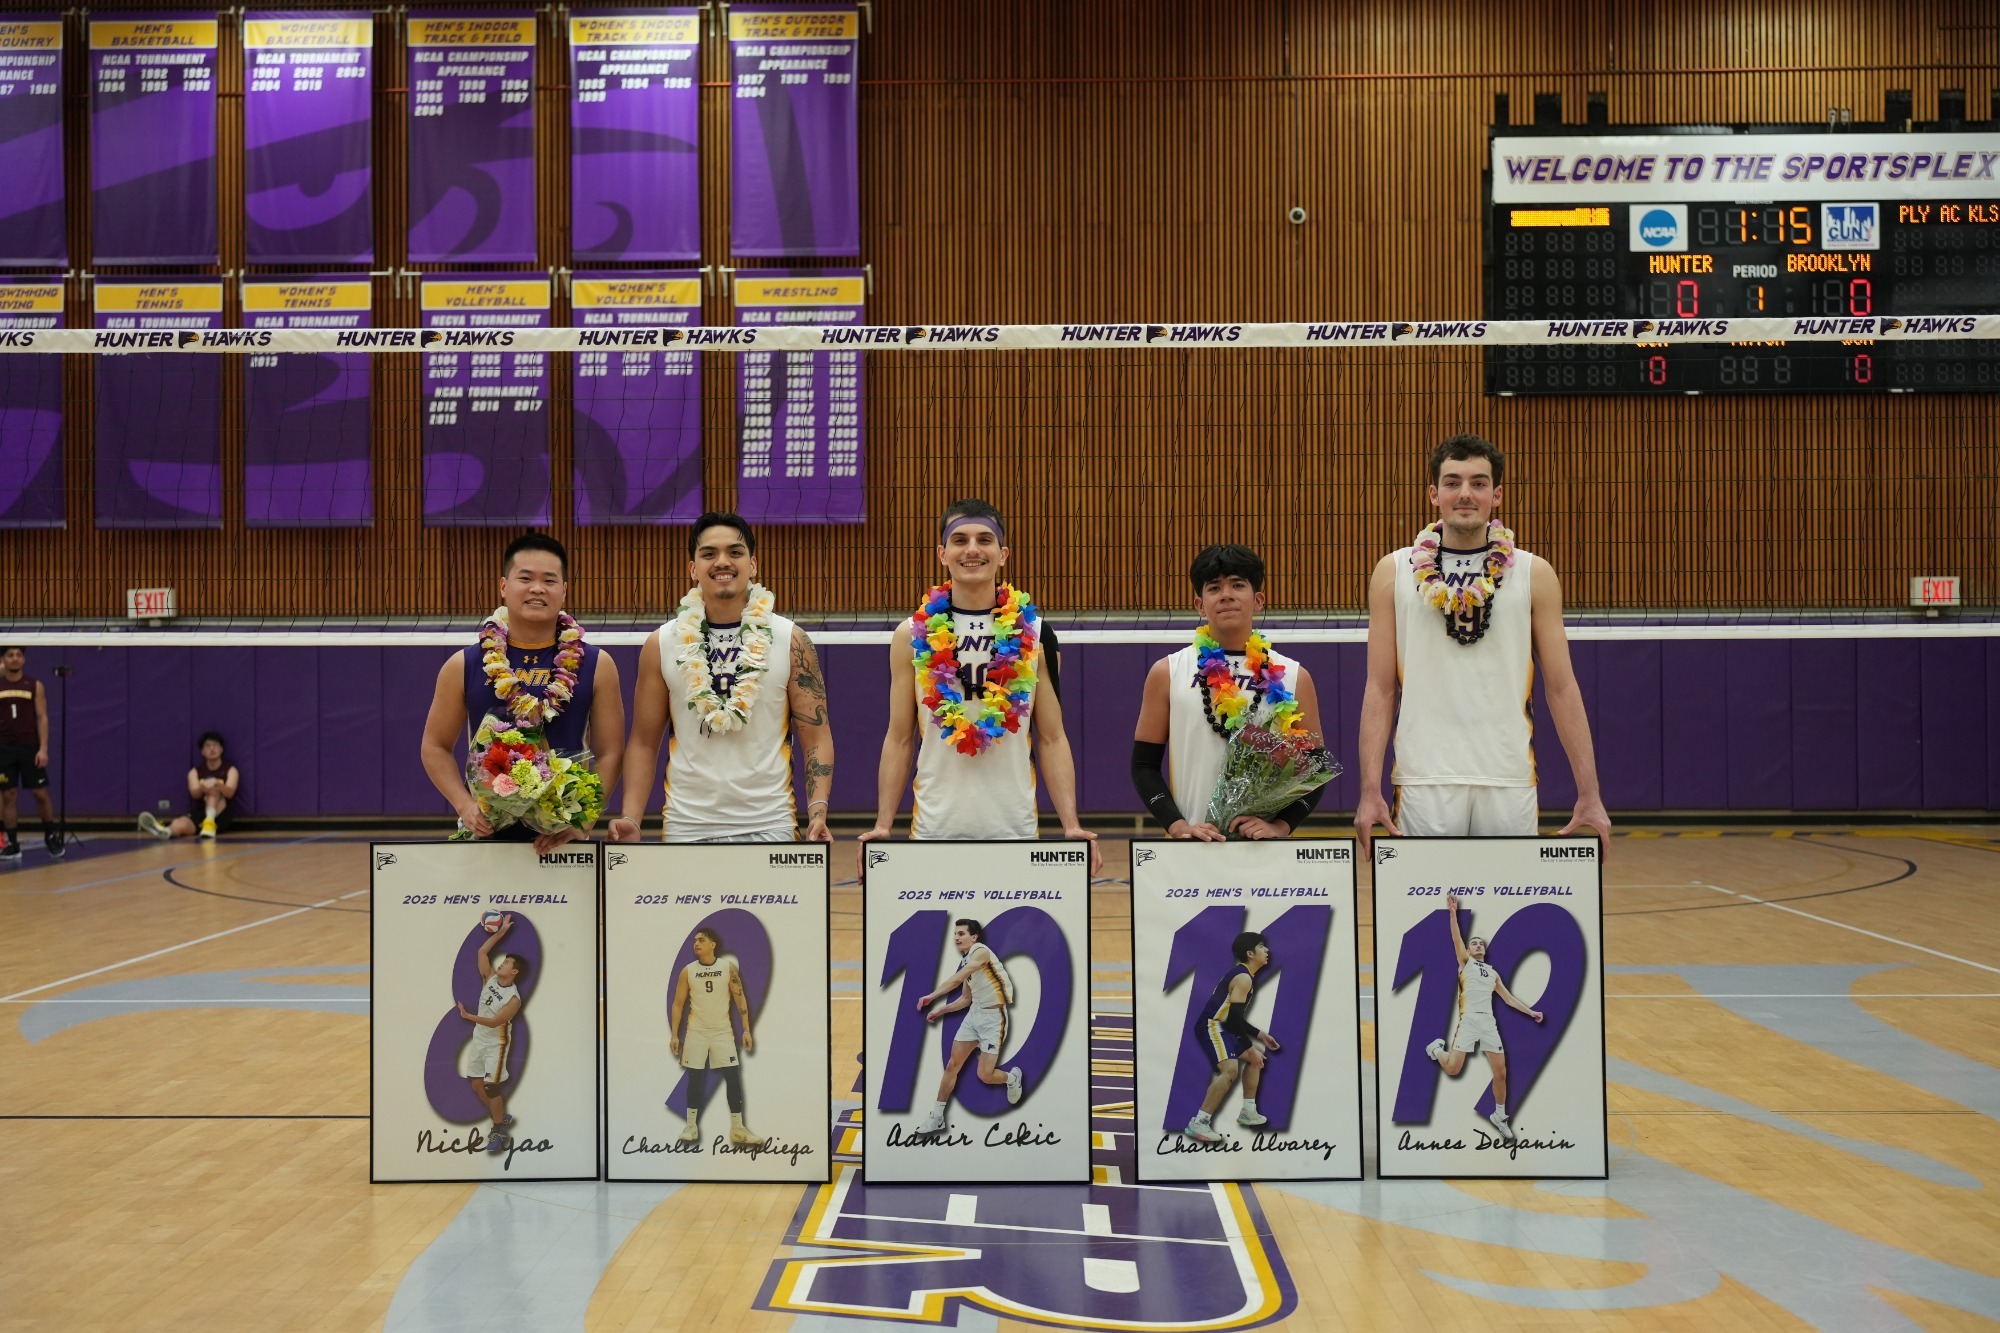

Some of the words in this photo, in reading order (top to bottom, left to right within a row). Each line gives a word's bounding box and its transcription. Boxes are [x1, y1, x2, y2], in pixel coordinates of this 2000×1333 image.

[425, 22, 465, 31] MEN'S
[468, 21, 519, 31] INDOOR
[579, 21, 636, 30] WOMEN'S
[640, 20, 691, 29] INDOOR
[742, 16, 781, 25] MEN'S
[785, 16, 845, 25] OUTDOOR
[134, 24, 173, 34] MEN'S
[280, 23, 338, 33] WOMEN'S
[746, 28, 787, 37] TRACK
[805, 28, 844, 36] FIELD
[111, 36, 196, 46] BASKETBALL
[266, 35, 350, 45] BASKETBALL
[424, 34, 466, 43] TRACK
[482, 34, 522, 43] FIELD
[586, 33, 628, 42] TRACK
[646, 32, 684, 41] FIELD
[415, 52, 444, 62] NCAA
[447, 51, 529, 62] CHAMPIONSHIP
[577, 50, 606, 61] NCAA
[610, 49, 691, 60] CHAMPIONSHIP
[736, 46, 765, 56] NCAA
[769, 45, 851, 56] CHAMPIONSHIP
[102, 54, 130, 65] NCAA
[135, 53, 206, 65] TOURNAMENT
[256, 53, 286, 64] NCAA
[289, 53, 361, 64] TOURNAMENT
[758, 59, 828, 70] APPEARANCE
[437, 65, 506, 76] APPEARANCE
[599, 63, 669, 75] APPEARANCE
[1504, 155, 1658, 184] WELCOME
[1664, 155, 1705, 183] TO
[1712, 154, 1775, 182] THE
[1781, 151, 1998, 182] SPORTSPLEX
[1900, 204, 1930, 223] PLY
[1941, 204, 1961, 222] AC
[1740, 207, 1812, 245] 1:15
[1642, 226, 1677, 239] NCAA
[1828, 226, 1873, 240] CUNY
[1650, 255, 1713, 273] HUNTER
[1787, 253, 1871, 272] BROOKLYN
[1733, 265, 1777, 278] PERIOD
[139, 287, 178, 297] MEN'S
[279, 286, 337, 296] WOMEN'S
[466, 285, 506, 294] MEN'S
[608, 283, 667, 293] WOMEN'S
[762, 288, 838, 296] WRESTLING
[284, 298, 332, 308] TENNIS
[446, 297, 526, 306] VOLLEYBALL
[596, 295, 677, 304] VOLLEYBALL
[1677, 280, 1698, 317] 0
[1758, 285, 1765, 311] 1
[1850, 279, 1871, 317] 0
[136, 300, 183, 309] TENNIS
[107, 317, 135, 328] NCAA
[140, 317, 211, 328] TOURNAMENT
[255, 316, 284, 328] NCAA
[288, 315, 360, 327] TOURNAMENT
[470, 314, 541, 326] TOURNAMENT
[584, 313, 613, 324] NCAA
[617, 312, 689, 323] TOURNAMENT
[742, 311, 771, 323] NCAA
[775, 311, 856, 322] CHAMPIONSHIP
[1306, 324, 1387, 340] HUNTER
[1415, 322, 1487, 338] HAWKS
[1547, 321, 1628, 337] HUNTER
[1656, 320, 1729, 336] HAWKS
[1793, 319, 1875, 335] HUNTER
[1904, 317, 1976, 333] HAWKS
[95, 332, 173, 347] HUNTER
[202, 331, 272, 347] HAWKS
[336, 331, 416, 347] HUNTER
[445, 330, 515, 346] HAWKS
[578, 330, 659, 345] HUNTER
[686, 328, 757, 345] HAWKS
[821, 328, 901, 344] HUNTER
[929, 327, 1000, 343] HAWKS
[1061, 326, 1142, 341] HUNTER
[1170, 325, 1241, 341] HAWKS
[1649, 355, 1666, 385] 0
[1855, 354, 1871, 383] 0
[434, 387, 463, 398] NCAA
[468, 386, 539, 397] TOURNAMENT
[1923, 580, 1954, 602] EXIT
[135, 592, 165, 615] EXIT
[11, 704, 17, 719] 1
[539, 853, 593, 864] HUNTER
[769, 853, 824, 864] HUNTER
[1031, 851, 1084, 862] HUNTER
[1296, 848, 1350, 860] HUNTER
[1540, 847, 1594, 859] HUNTER
[898, 891, 932, 900] 2025
[938, 890, 975, 900] MEN'S
[983, 890, 1062, 900] VOLLEYBALL
[1165, 889, 1200, 898] 2025
[1206, 888, 1242, 898] MEN'S
[1250, 887, 1328, 897] VOLLEYBALL
[1407, 887, 1441, 896] 2025
[1447, 886, 1485, 896] MEN'S
[1493, 886, 1573, 896] VOLLEYBALL
[402, 895, 437, 904] 2025
[444, 894, 480, 904] MEN'S
[489, 894, 568, 904] VOLLEYBALL
[634, 895, 668, 904] 2025
[675, 894, 712, 904] MEN'S
[720, 894, 799, 904] VOLLEYBALL
[705, 980, 714, 993] 9
[878, 905, 1073, 1118] 10
[1392, 902, 1587, 1122] 19
[1163, 905, 1331, 1131] 11
[984, 1121, 1061, 1148] Cekic
[1398, 1130, 1466, 1151] Annes
[417, 1127, 487, 1155] Nick
[622, 1135, 704, 1154] Charles
[1157, 1134, 1243, 1155] Charlie
[1251, 1131, 1336, 1161] Alvarez
